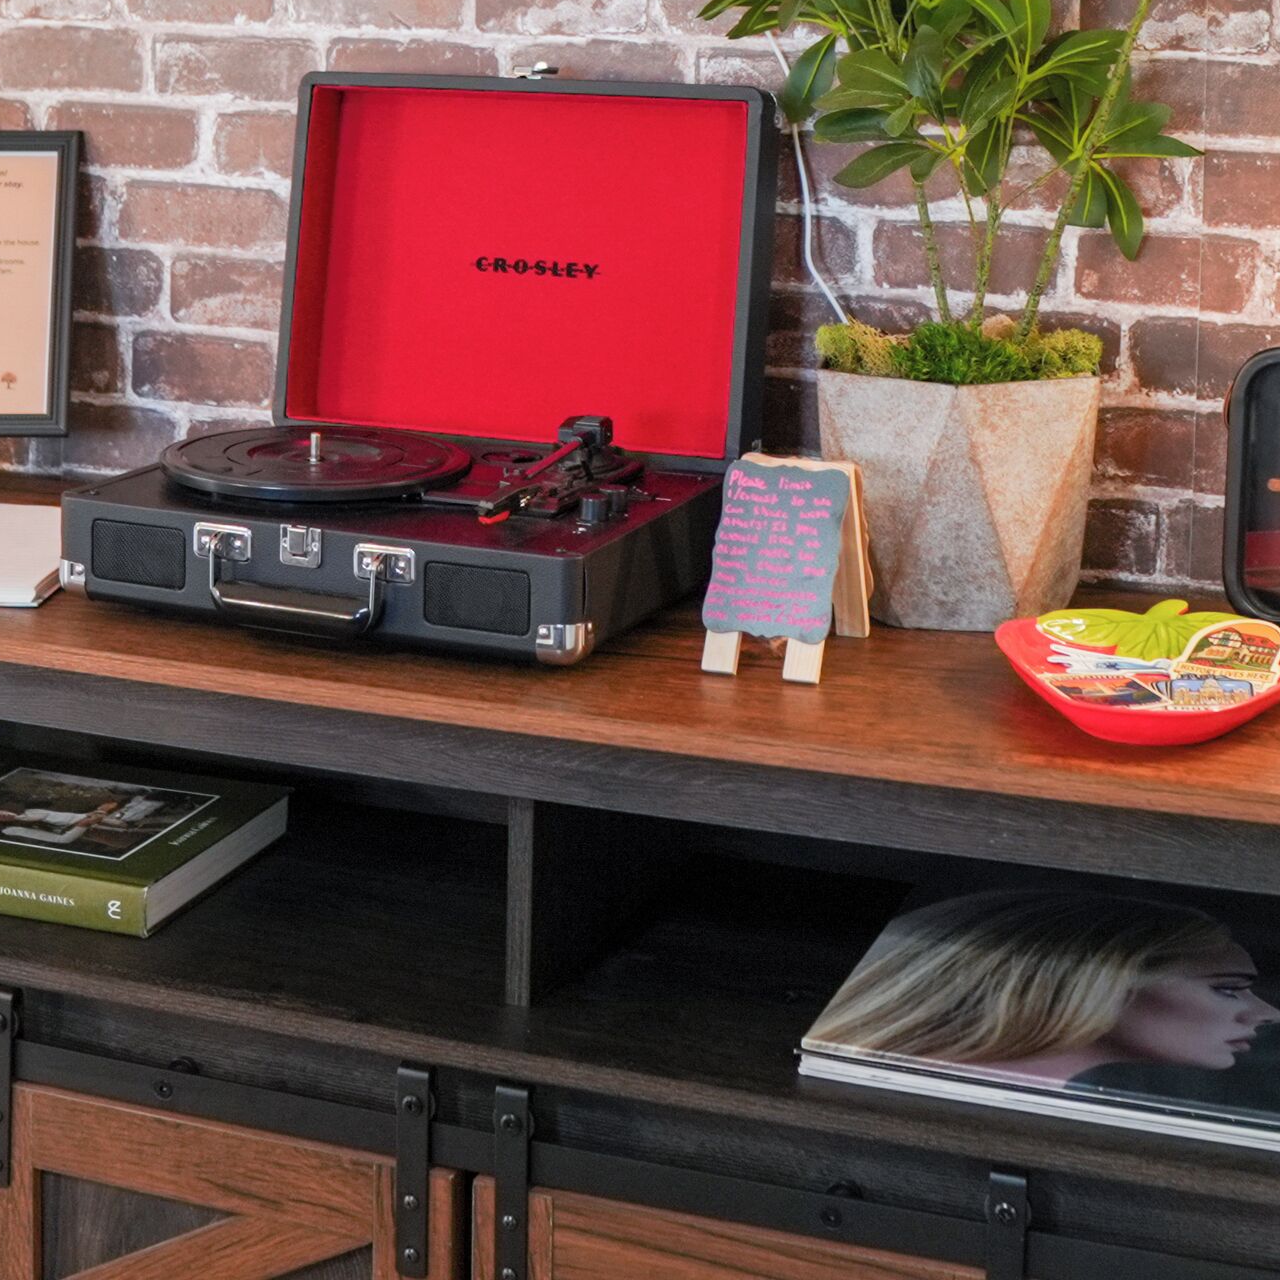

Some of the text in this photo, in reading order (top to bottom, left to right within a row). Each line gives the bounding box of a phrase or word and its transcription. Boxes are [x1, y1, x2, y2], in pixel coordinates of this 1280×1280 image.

[475, 256, 600, 279] CROSLEY
[729, 469, 813, 490] Please limit
[1180, 664, 1271, 680] HISTORY LIVES HERE
[0, 886, 37, 901] JOANNA
[40, 892, 75, 907] GAINES
